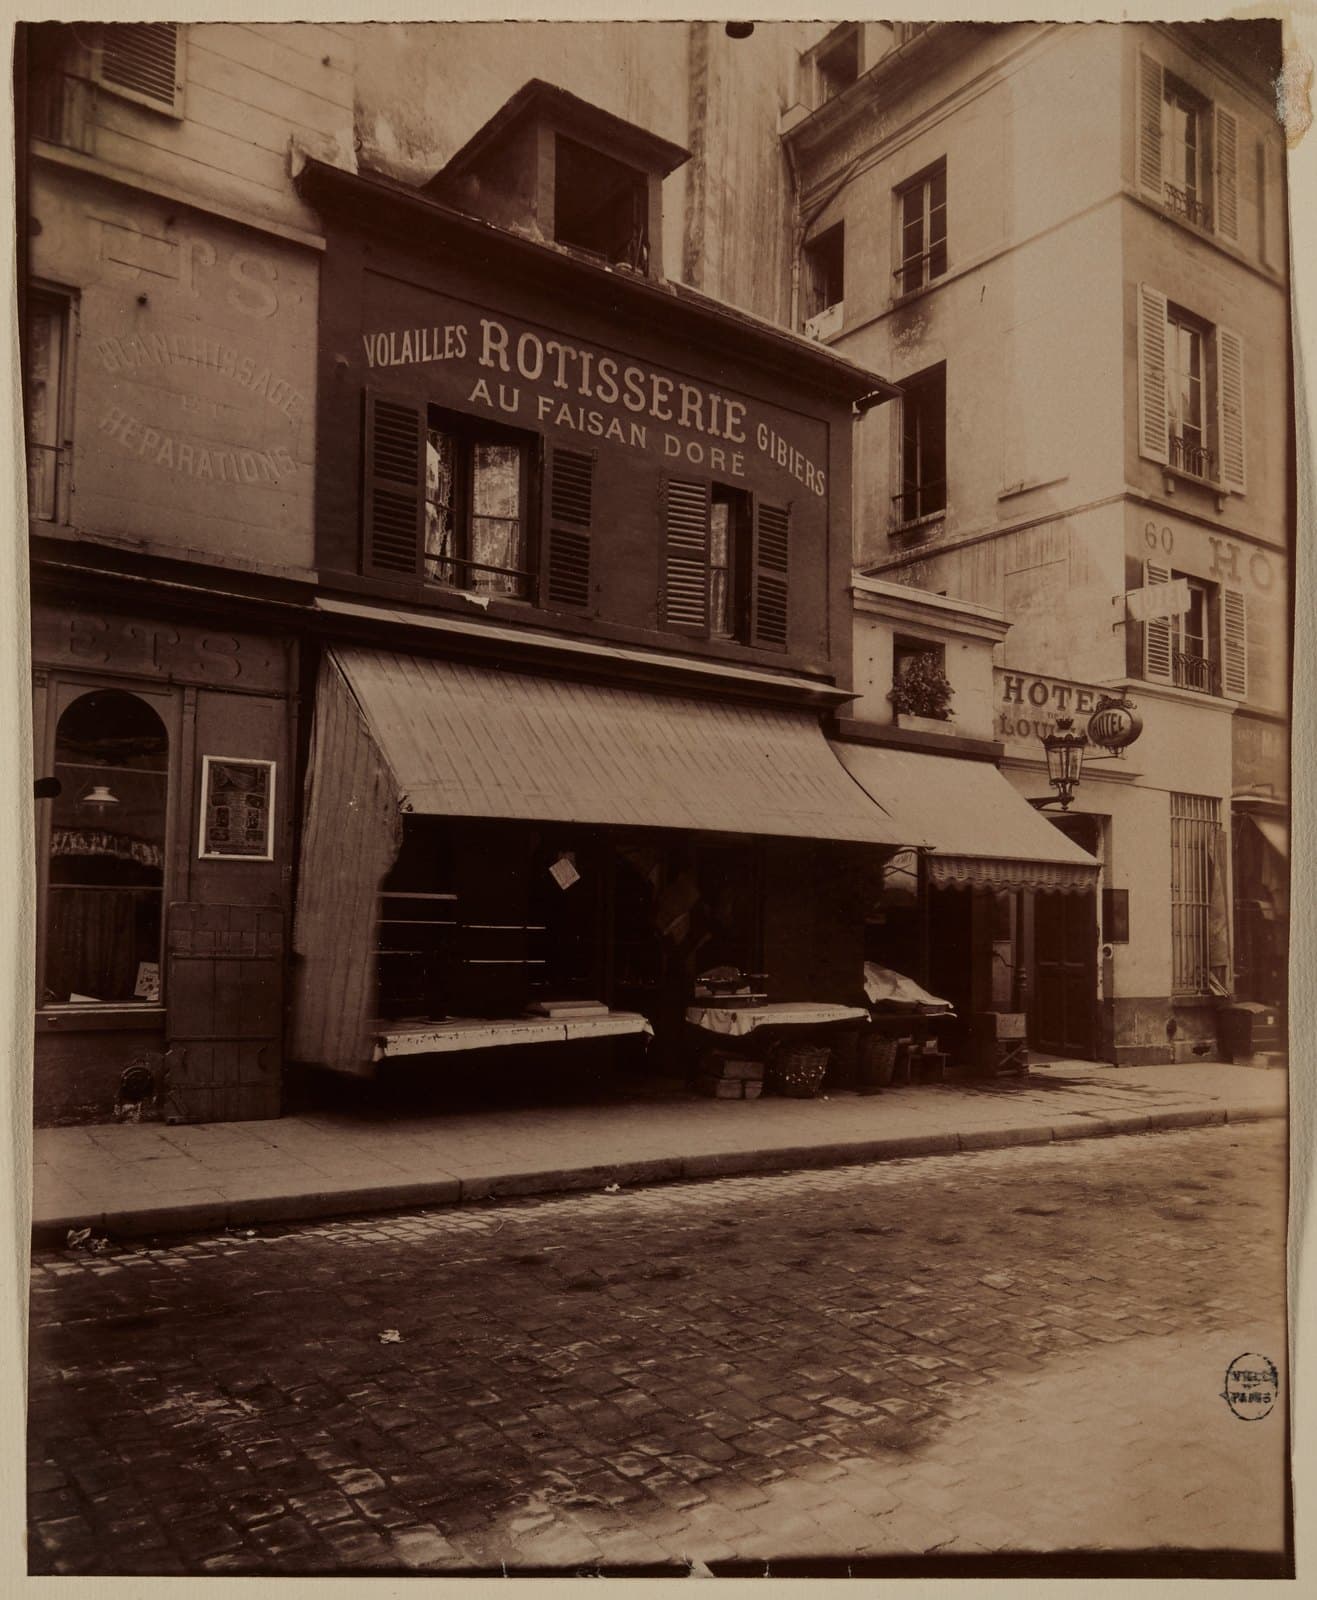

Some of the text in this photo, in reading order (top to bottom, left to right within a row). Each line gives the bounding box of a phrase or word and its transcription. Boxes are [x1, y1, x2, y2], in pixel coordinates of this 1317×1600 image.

[363, 324, 469, 369] VOLAILLES
[478, 317, 747, 444] ROTISSERIE
[467, 377, 521, 413] AU
[536, 394, 647, 449] FAISAN
[757, 422, 826, 496] GIBIERS
[1144, 521, 1175, 555] 60
